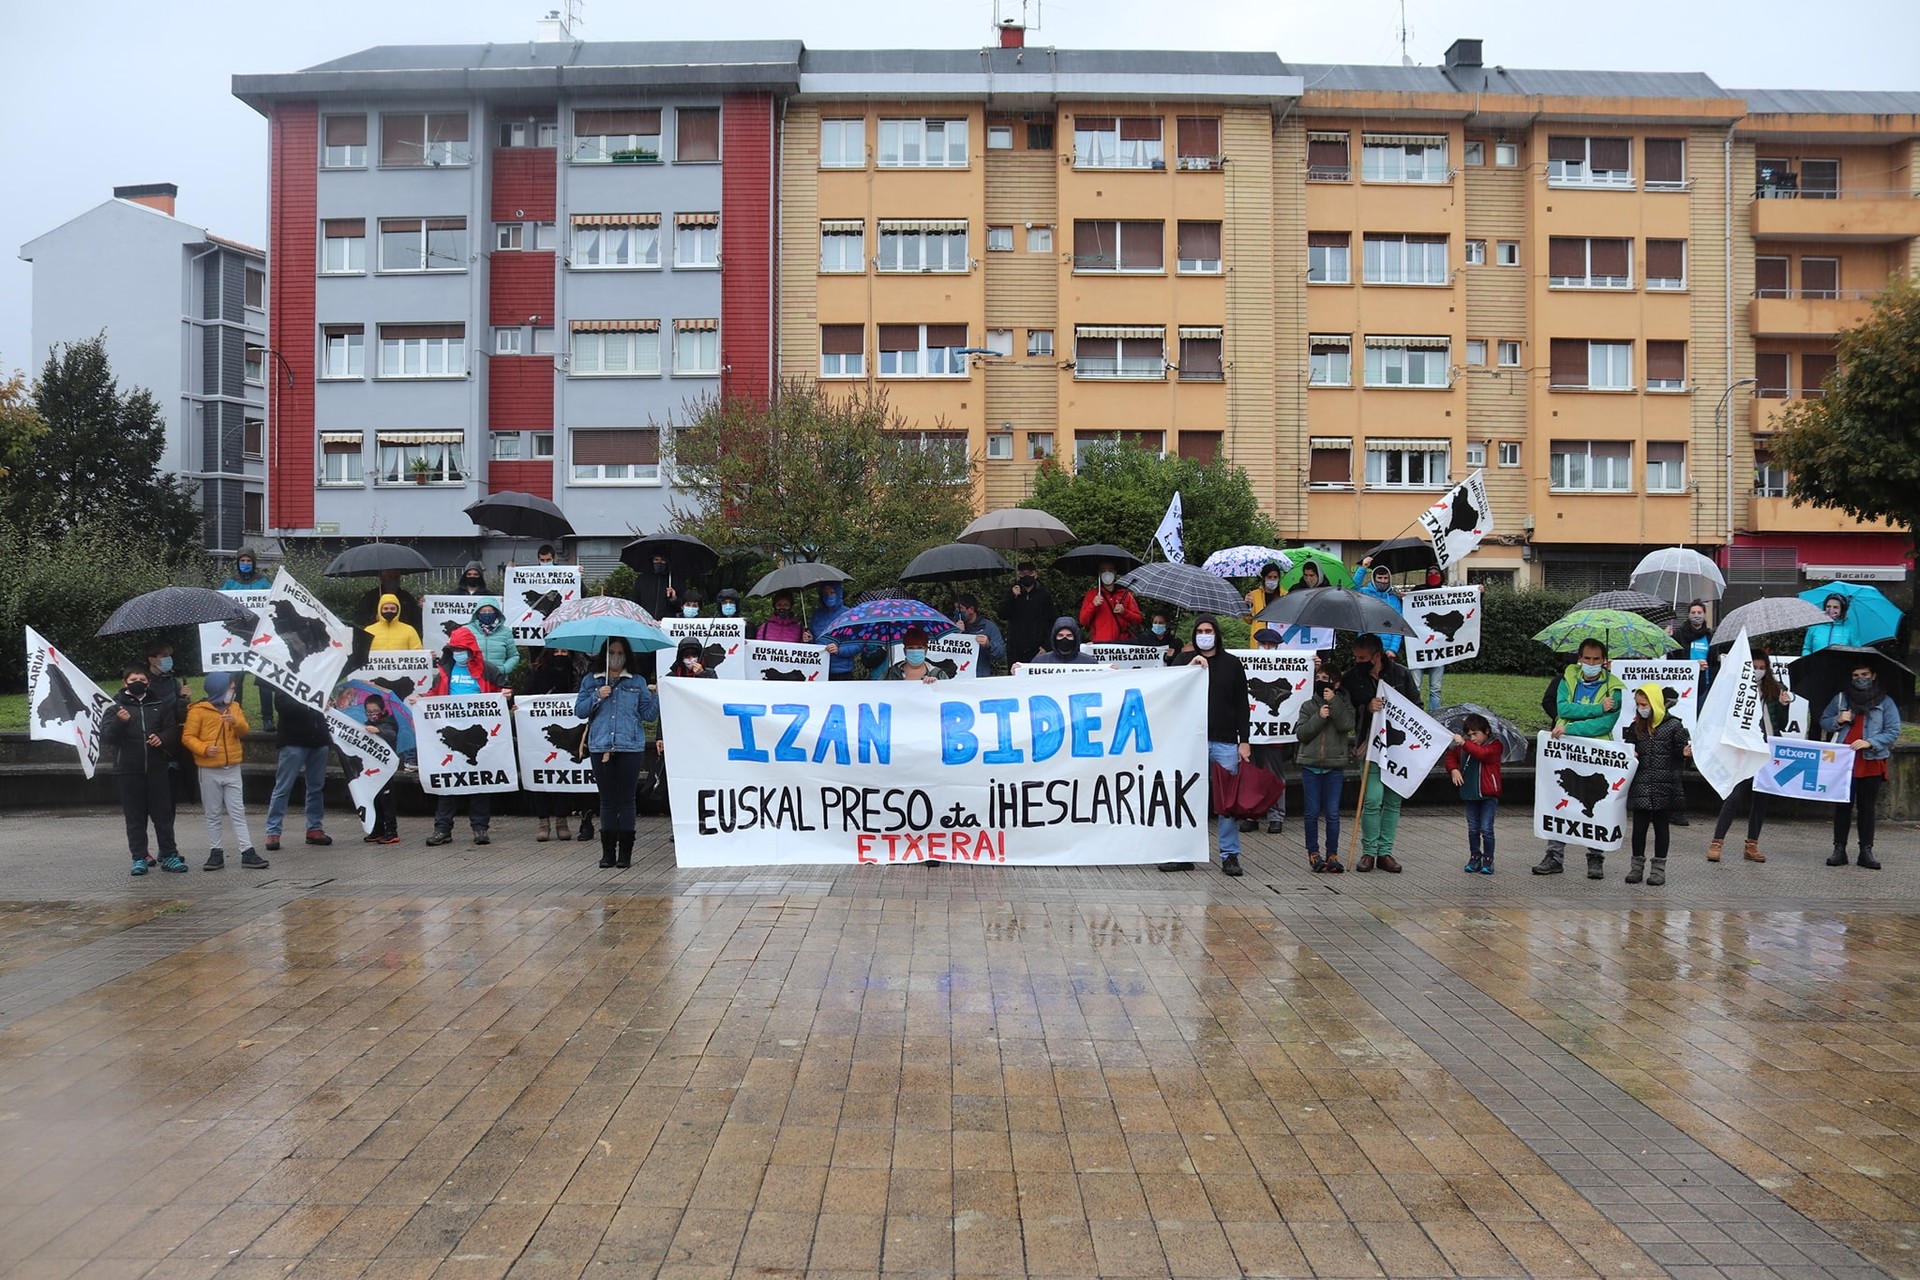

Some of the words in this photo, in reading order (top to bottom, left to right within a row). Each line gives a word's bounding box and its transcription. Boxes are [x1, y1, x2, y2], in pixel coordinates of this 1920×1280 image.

[1420, 510, 1450, 566] ETXERA
[1414, 594, 1444, 602] EUSKAL
[1428, 598, 1476, 606] IHESLARIAK
[512, 626, 548, 640] ETX
[688, 630, 741, 638] IHESLARIAK
[755, 646, 788, 656] EUSKAL
[792, 650, 820, 658] PRESO
[928, 646, 973, 654] HESLARIAK
[944, 640, 971, 648] PRESO
[1416, 642, 1475, 662] ETXERA
[770, 655, 822, 665] IHESLARIAK
[1240, 656, 1272, 664] USKAL
[1253, 664, 1308, 672] IHESLARIAK
[245, 650, 324, 708] ETXERA
[1624, 666, 1659, 674] EUSKAL
[1662, 666, 1692, 674] PRESO
[1733, 682, 1748, 718] PRESO
[1741, 660, 1752, 680] ETA
[426, 702, 464, 712] EUSKAL
[468, 701, 498, 709] PRESO
[445, 709, 502, 718] IHESLARIAK
[88, 692, 113, 766] ETXERA
[326, 715, 360, 738] EUSKAL
[362, 734, 390, 756] PRESO
[723, 702, 891, 765] IZAN
[940, 688, 1153, 765] BIDEA
[1386, 709, 1432, 750] IHESLARIAK
[1408, 717, 1432, 740] PRESO
[338, 731, 390, 764] IHESLARIAK
[1546, 740, 1587, 755] EUSKAL
[1591, 748, 1626, 760] PRESO
[1779, 748, 1816, 760] etxera
[1373, 735, 1408, 780] ETRA
[1544, 749, 1562, 759] ETA
[1566, 752, 1629, 770] IHESLARIAK
[430, 770, 510, 788] ETXERA
[533, 770, 598, 784] ETXER
[698, 785, 816, 836] EUSKAL
[820, 786, 934, 832] PRESO
[940, 802, 982, 828] eta
[1543, 814, 1622, 842] ETXERA
[857, 830, 1006, 863] ETXERA!
